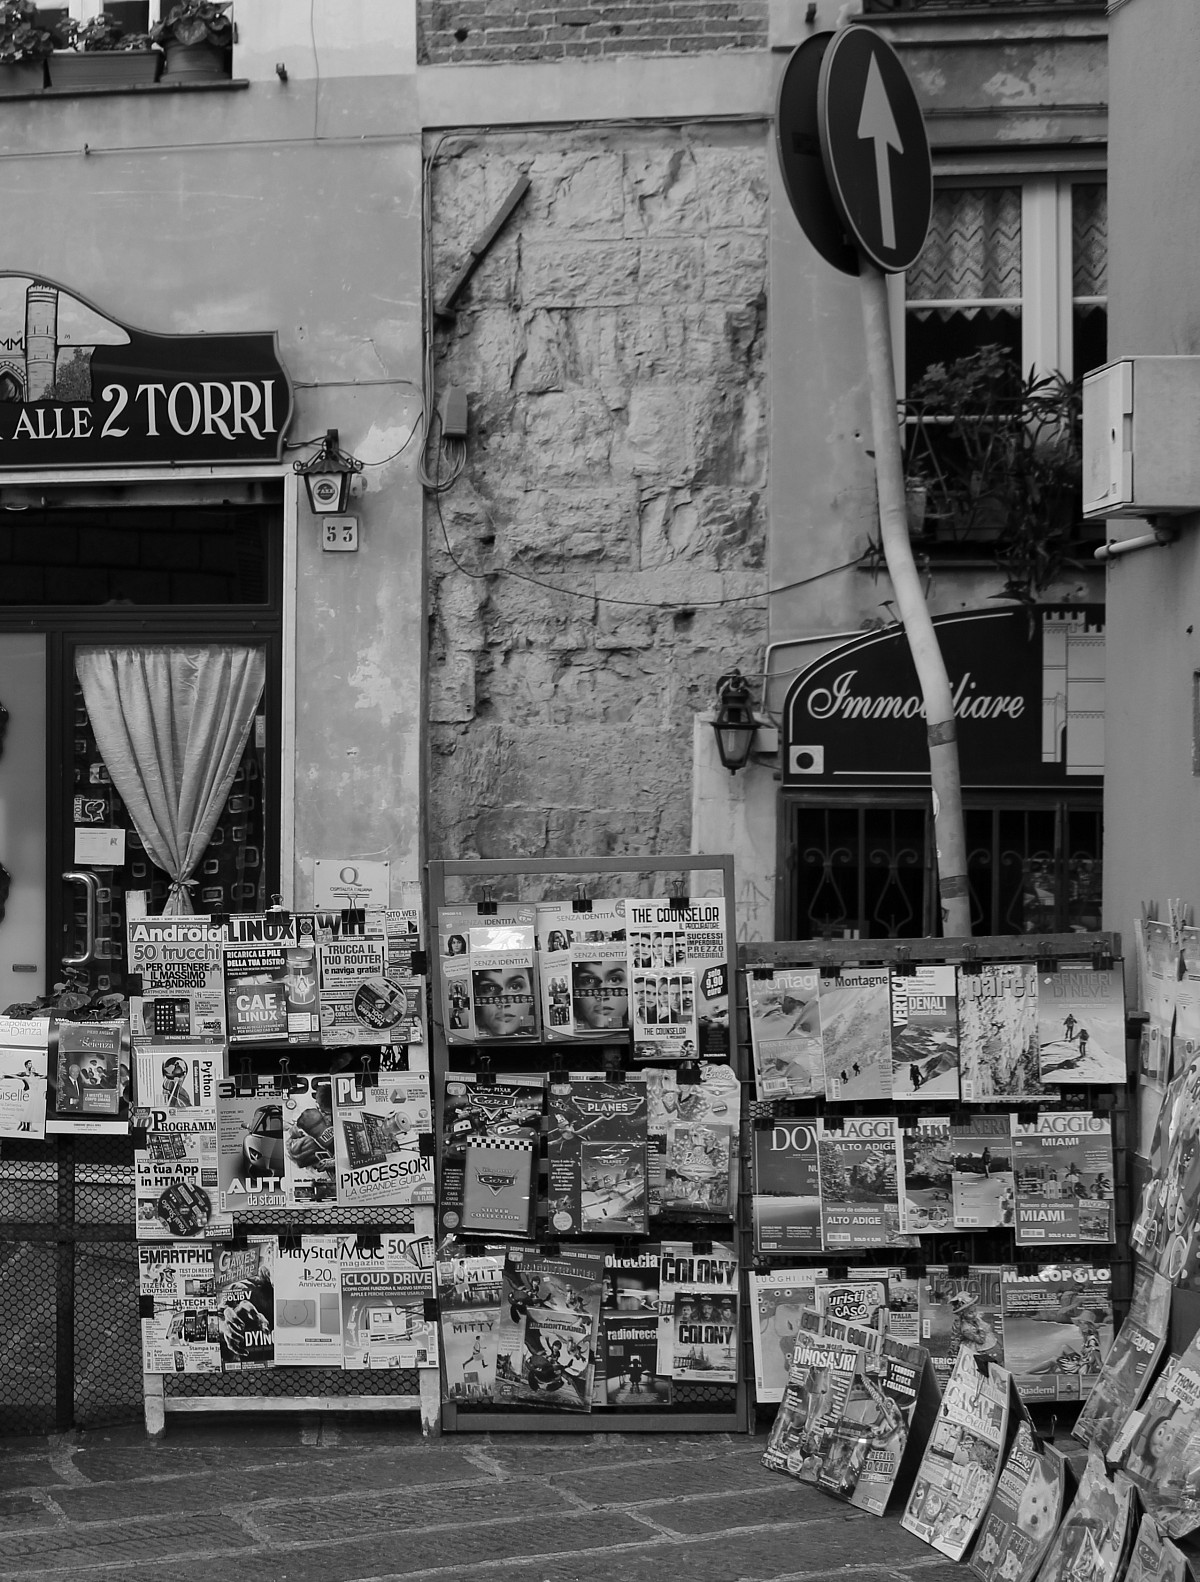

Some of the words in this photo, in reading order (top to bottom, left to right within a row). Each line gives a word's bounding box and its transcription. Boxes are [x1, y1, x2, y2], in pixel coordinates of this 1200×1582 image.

[11, 408, 93, 440] ALLE
[101, 384, 131, 439] 2
[135, 380, 277, 441] TORRI
[327, 526, 353, 542] 53
[632, 908, 652, 922] THE
[657, 907, 719, 922] COUNSELOR
[132, 925, 222, 942] Android
[162, 944, 220, 961] trucchi
[328, 945, 365, 954] TRUCCA
[227, 959, 246, 967] DELLA
[323, 956, 341, 965] TUO
[344, 955, 381, 964] ROUTER
[146, 963, 162, 971] PER
[165, 963, 210, 971] OTTENERE
[161, 971, 205, 979] MASSIMO
[1052, 973, 1113, 985] SENTIERI
[834, 974, 889, 990] Montagne
[236, 994, 277, 1011] CAE
[908, 996, 947, 1010] DENALI
[238, 1011, 278, 1022] LINUX
[10, 1026, 42, 1036] Danza
[200, 1060, 213, 1098] Python
[588, 1102, 628, 1112] PLANES
[834, 1142, 862, 1151] ALTO
[1041, 1137, 1079, 1147] MIAMI
[175, 1164, 198, 1177] App
[340, 1157, 432, 1189] PROCESSORI
[827, 1216, 851, 1225] ALTO
[853, 1216, 881, 1225] ADIGE
[1020, 1210, 1065, 1222] MIAMI
[662, 1257, 738, 1284] COLONY
[299, 1281, 336, 1289] Anniversary
[342, 1274, 390, 1286] iCLOUD
[393, 1273, 432, 1284] DRIVE
[453, 1322, 494, 1334] MITTY
[678, 1325, 734, 1344] COLONY
